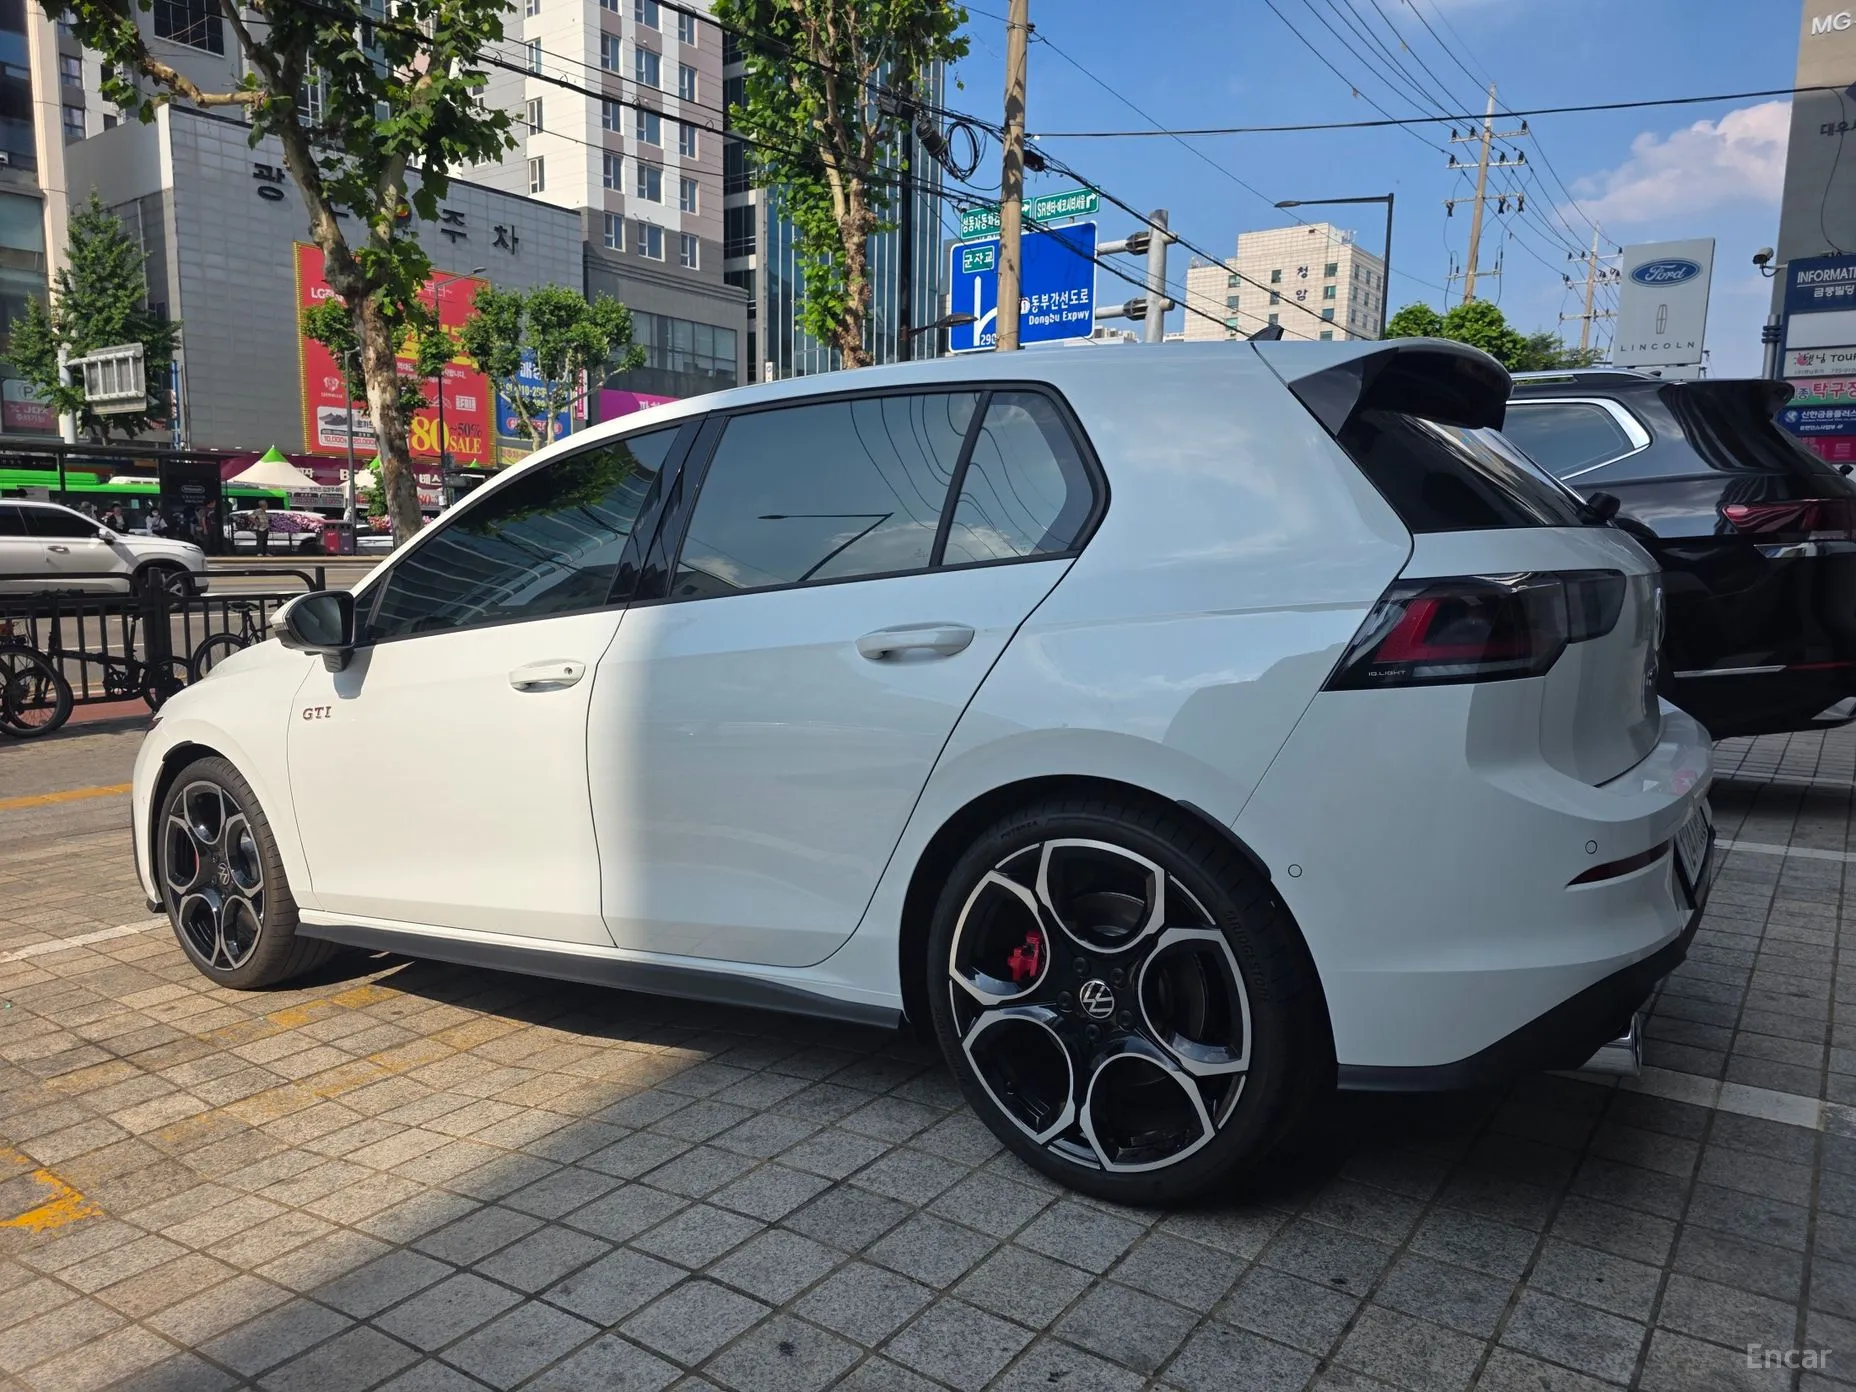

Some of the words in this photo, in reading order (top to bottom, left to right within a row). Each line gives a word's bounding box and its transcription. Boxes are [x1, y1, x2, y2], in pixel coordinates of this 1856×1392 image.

[1811, 12, 1851, 35] MG
[964, 251, 993, 268] 군자교
[1645, 264, 1687, 281] Ford
[1031, 288, 1089, 313] 동부간선도로
[1029, 313, 1060, 326] Dongbu
[1063, 310, 1090, 321] Expwy
[1620, 341, 1695, 352] LINCOLN
[411, 416, 450, 453] 80
[450, 436, 482, 454] SALE
[302, 706, 332, 720] GTI
